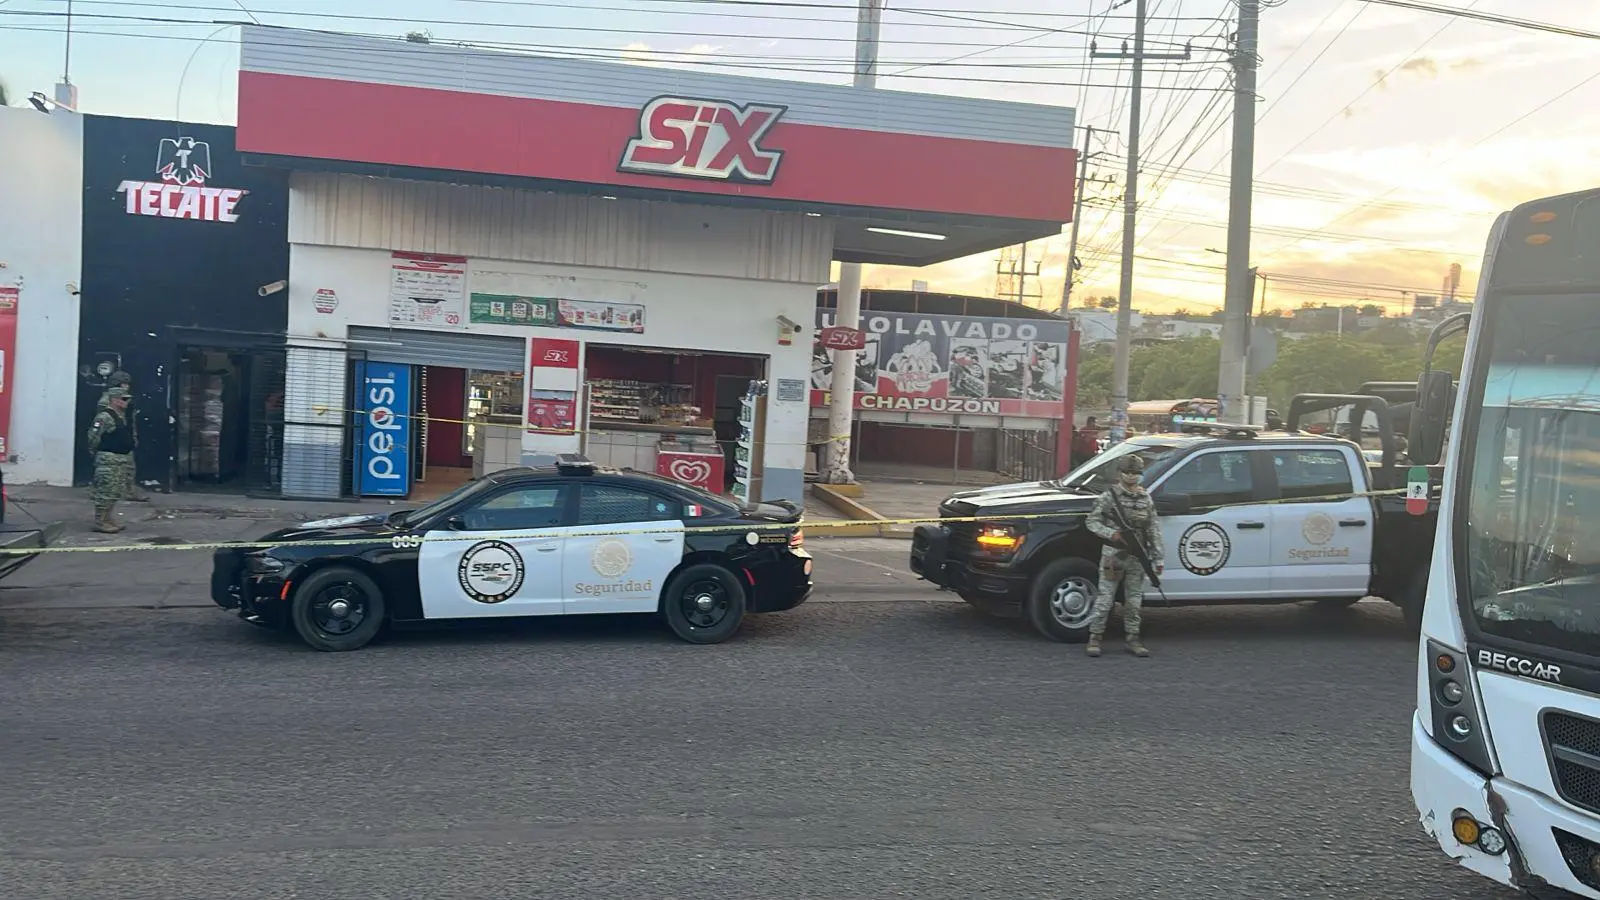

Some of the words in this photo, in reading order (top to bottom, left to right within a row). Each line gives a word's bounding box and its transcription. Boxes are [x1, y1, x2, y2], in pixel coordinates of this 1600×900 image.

[116, 180, 242, 223] TECATE
[365, 377, 402, 479] pepsi
[1288, 545, 1350, 560] Seguridad
[472, 562, 512, 572] SSPC
[575, 579, 653, 596] Seguridad
[1478, 650, 1561, 682] BECCAR
